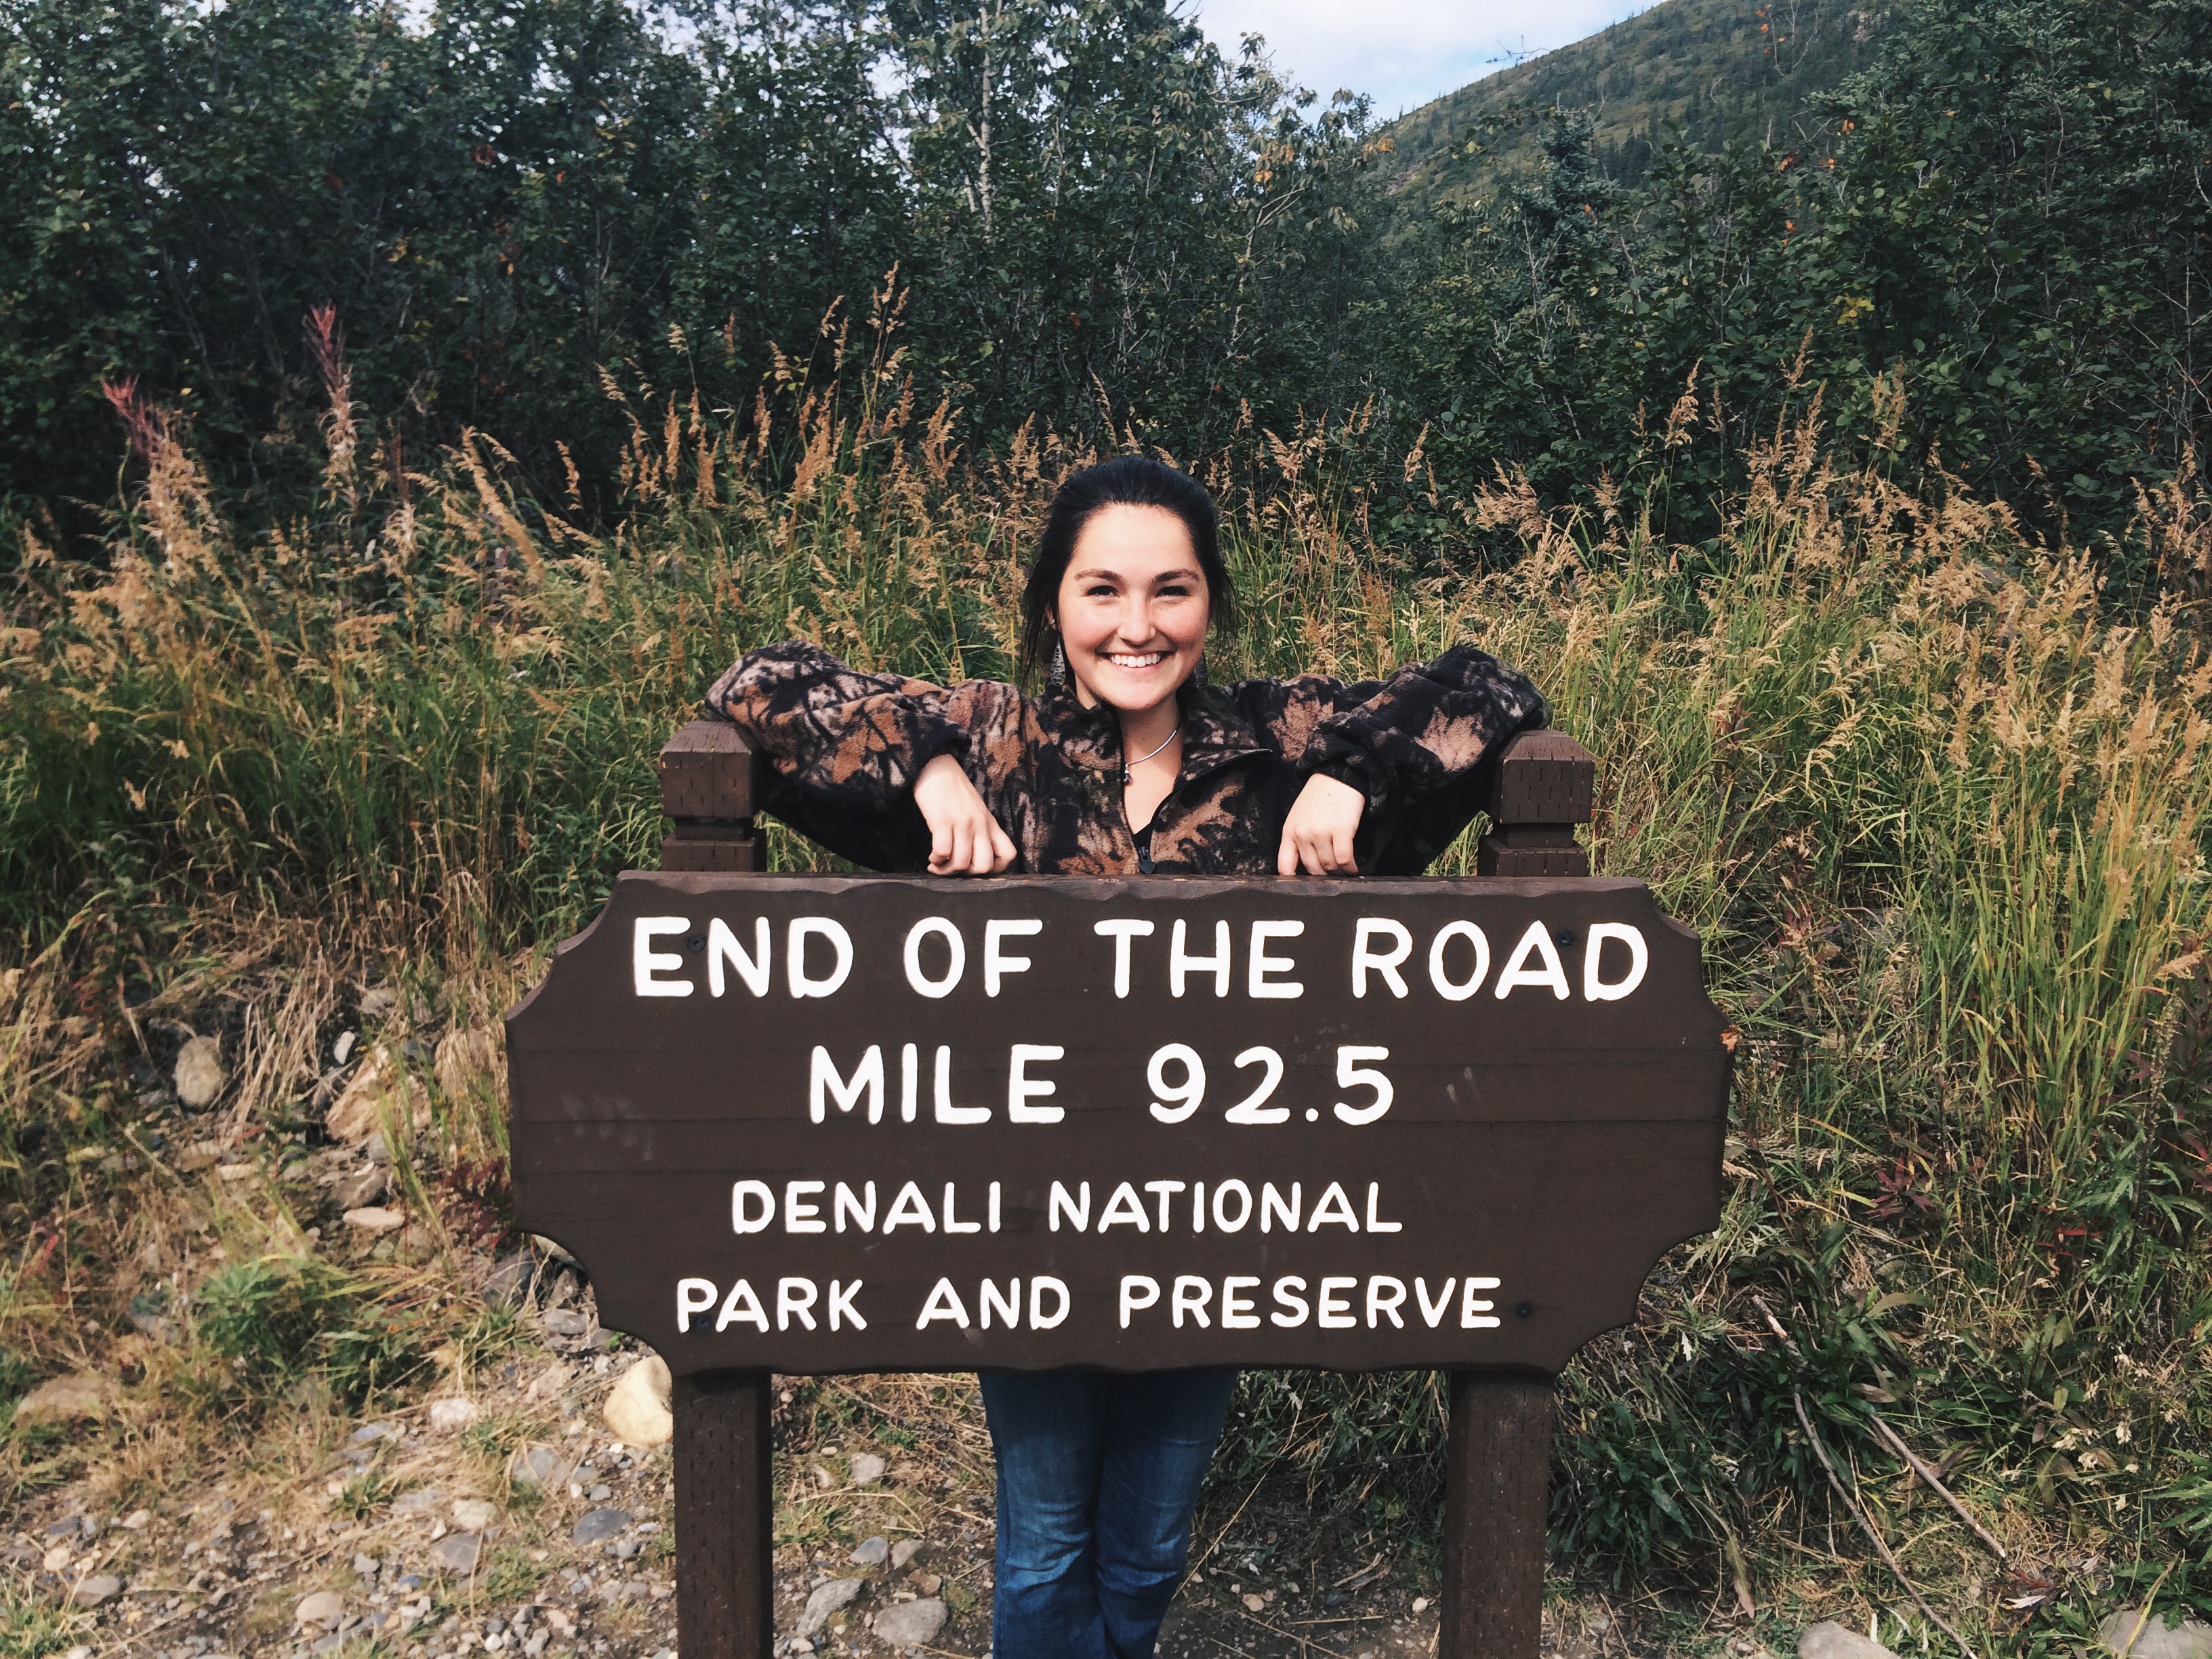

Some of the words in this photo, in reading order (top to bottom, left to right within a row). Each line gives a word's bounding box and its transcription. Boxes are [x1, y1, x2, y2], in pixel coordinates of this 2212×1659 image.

[633, 916, 853, 999] END
[903, 916, 1043, 998] OF
[1093, 918, 1305, 999] THE
[1351, 917, 1648, 1002] ROAD
[809, 1042, 1065, 1125] MILE
[1147, 1042, 1394, 1126] 92.5
[732, 1180, 1002, 1235] DENALI
[1048, 1179, 1403, 1233] NATIONAL
[676, 1277, 867, 1333] PARK
[916, 1275, 1071, 1330] AND
[1120, 1275, 1501, 1329] PRESERVE
